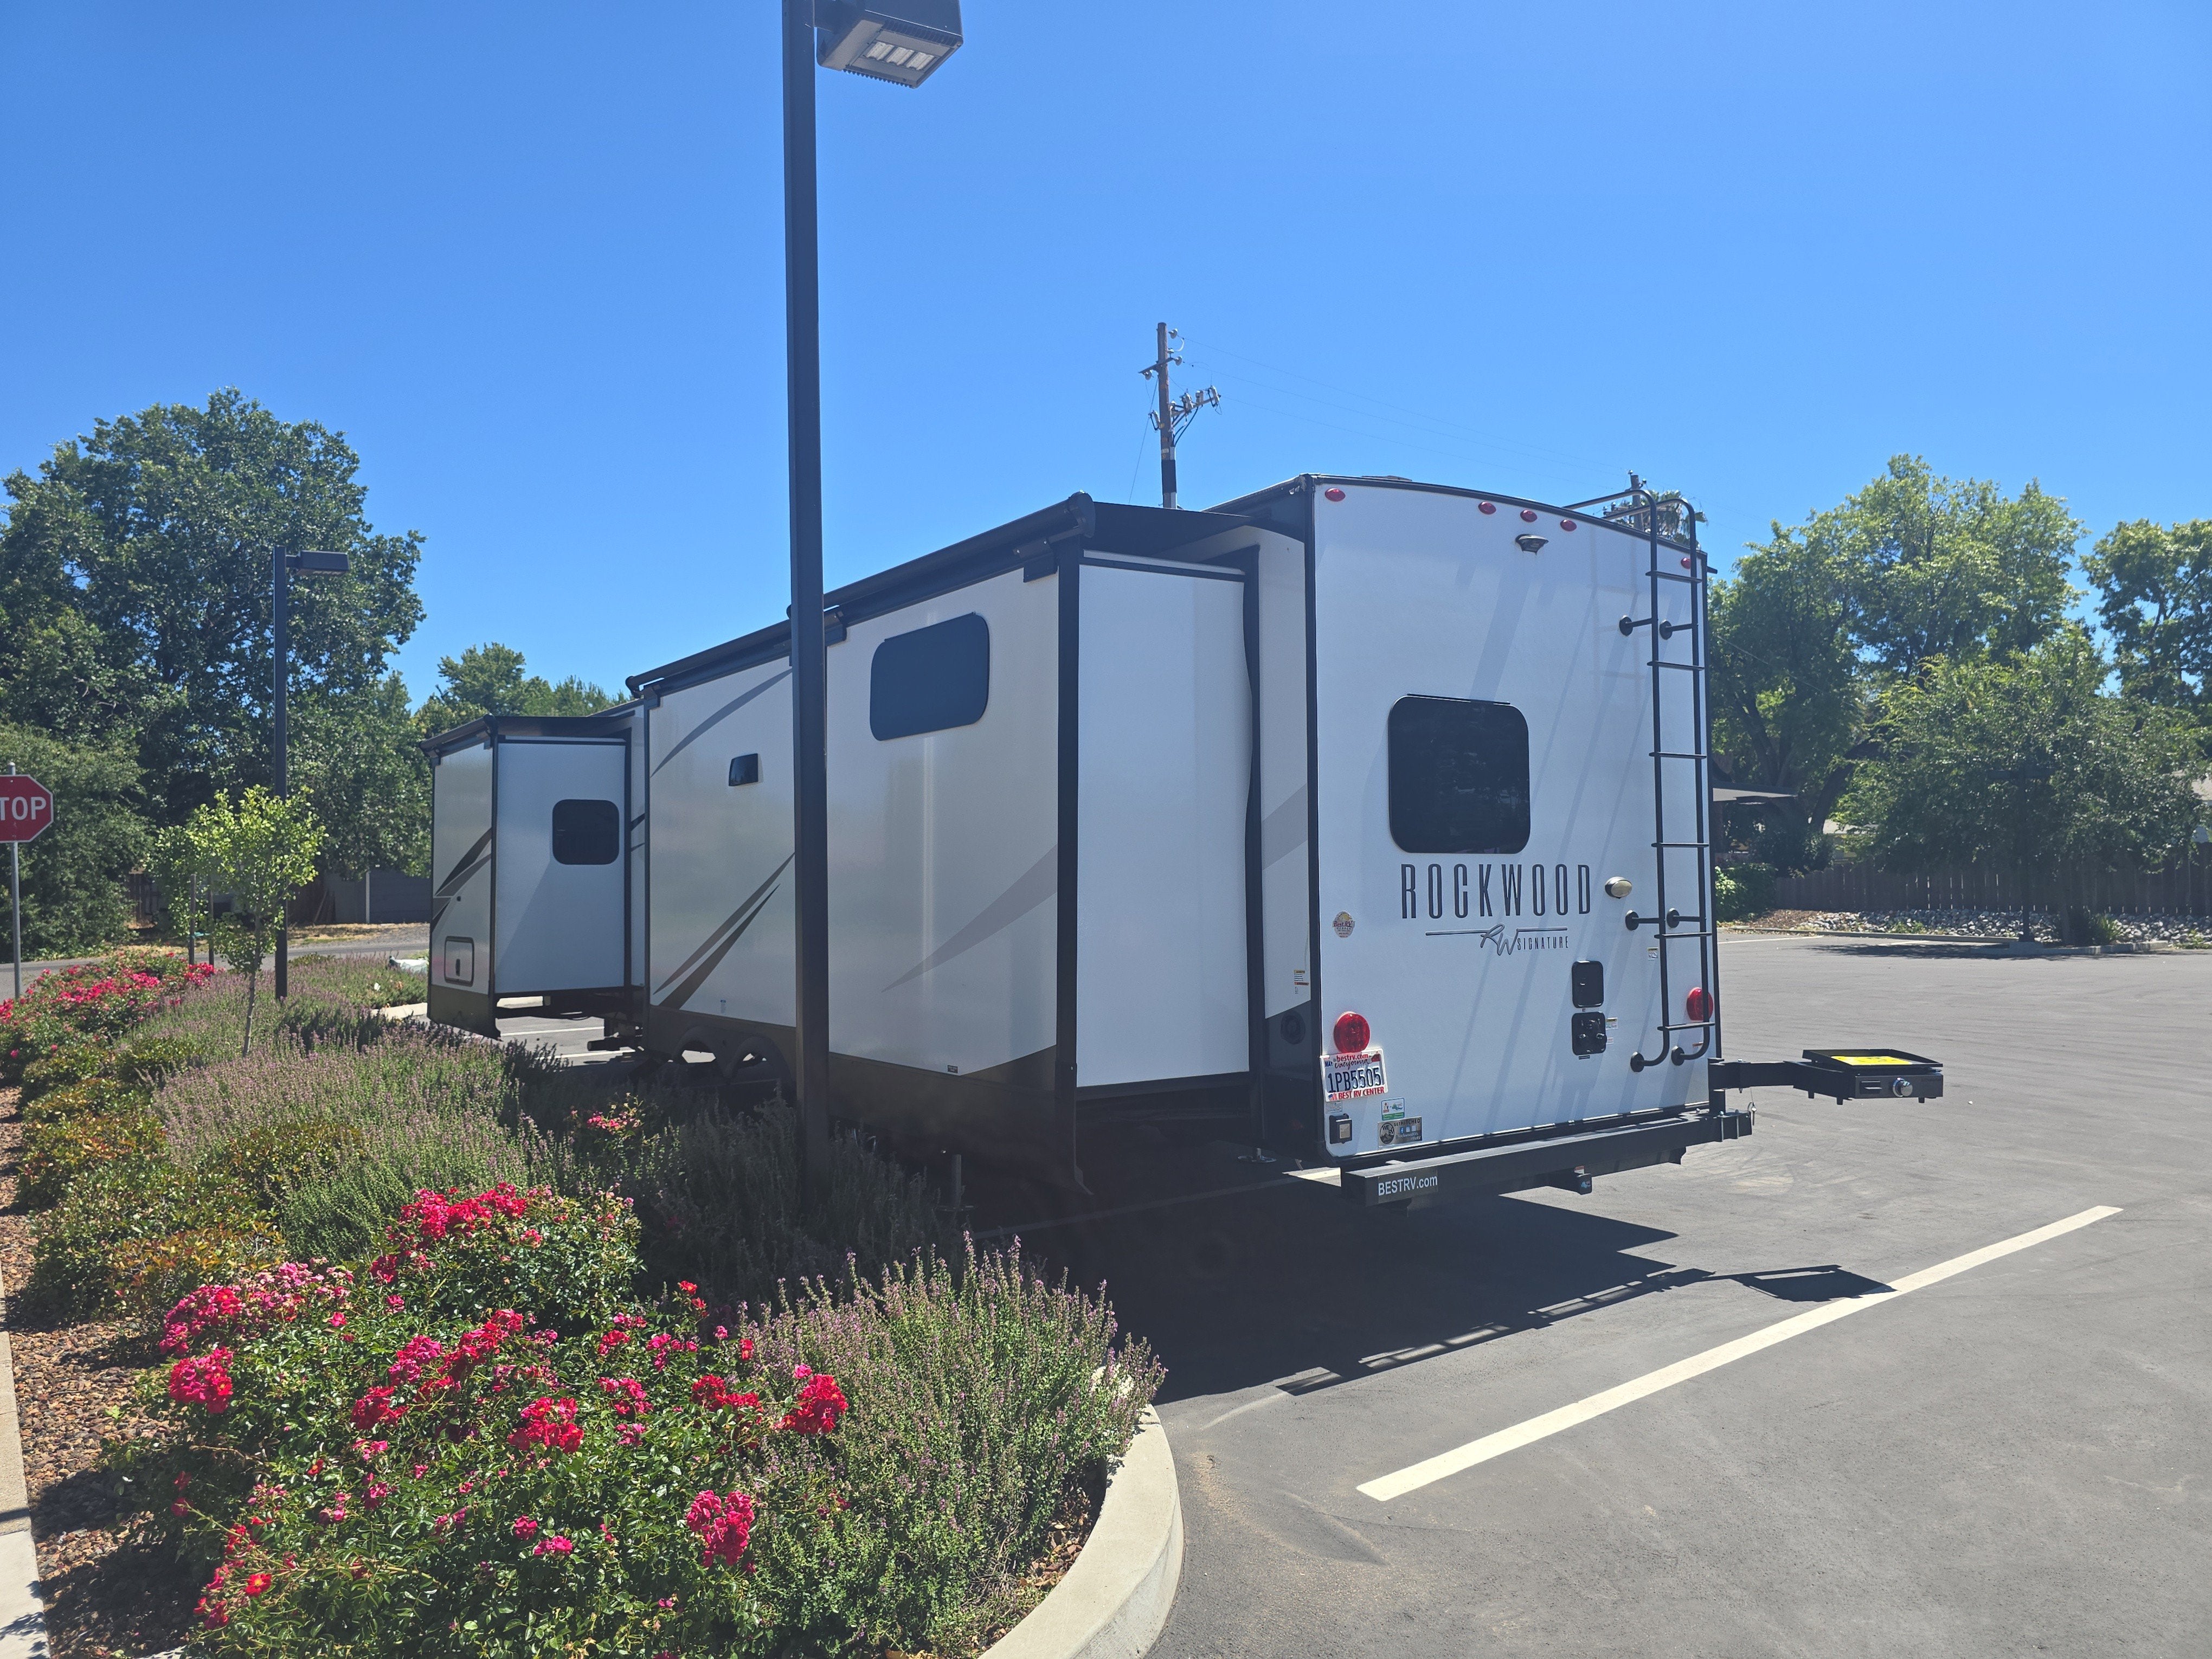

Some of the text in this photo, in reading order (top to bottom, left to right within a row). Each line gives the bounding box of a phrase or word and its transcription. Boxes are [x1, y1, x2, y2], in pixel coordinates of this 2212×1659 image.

[0, 796, 47, 820] TOP
[1401, 863, 1591, 919] ROCKWOOD
[1517, 936, 1568, 950] SIGNATURE
[1336, 1053, 1369, 1062] bestrv.com
[1327, 1067, 1382, 1093] 1PB5505
[1339, 1086, 1385, 1100] BEST RV CENTER
[1378, 1176, 1438, 1196] BESTRV.com
